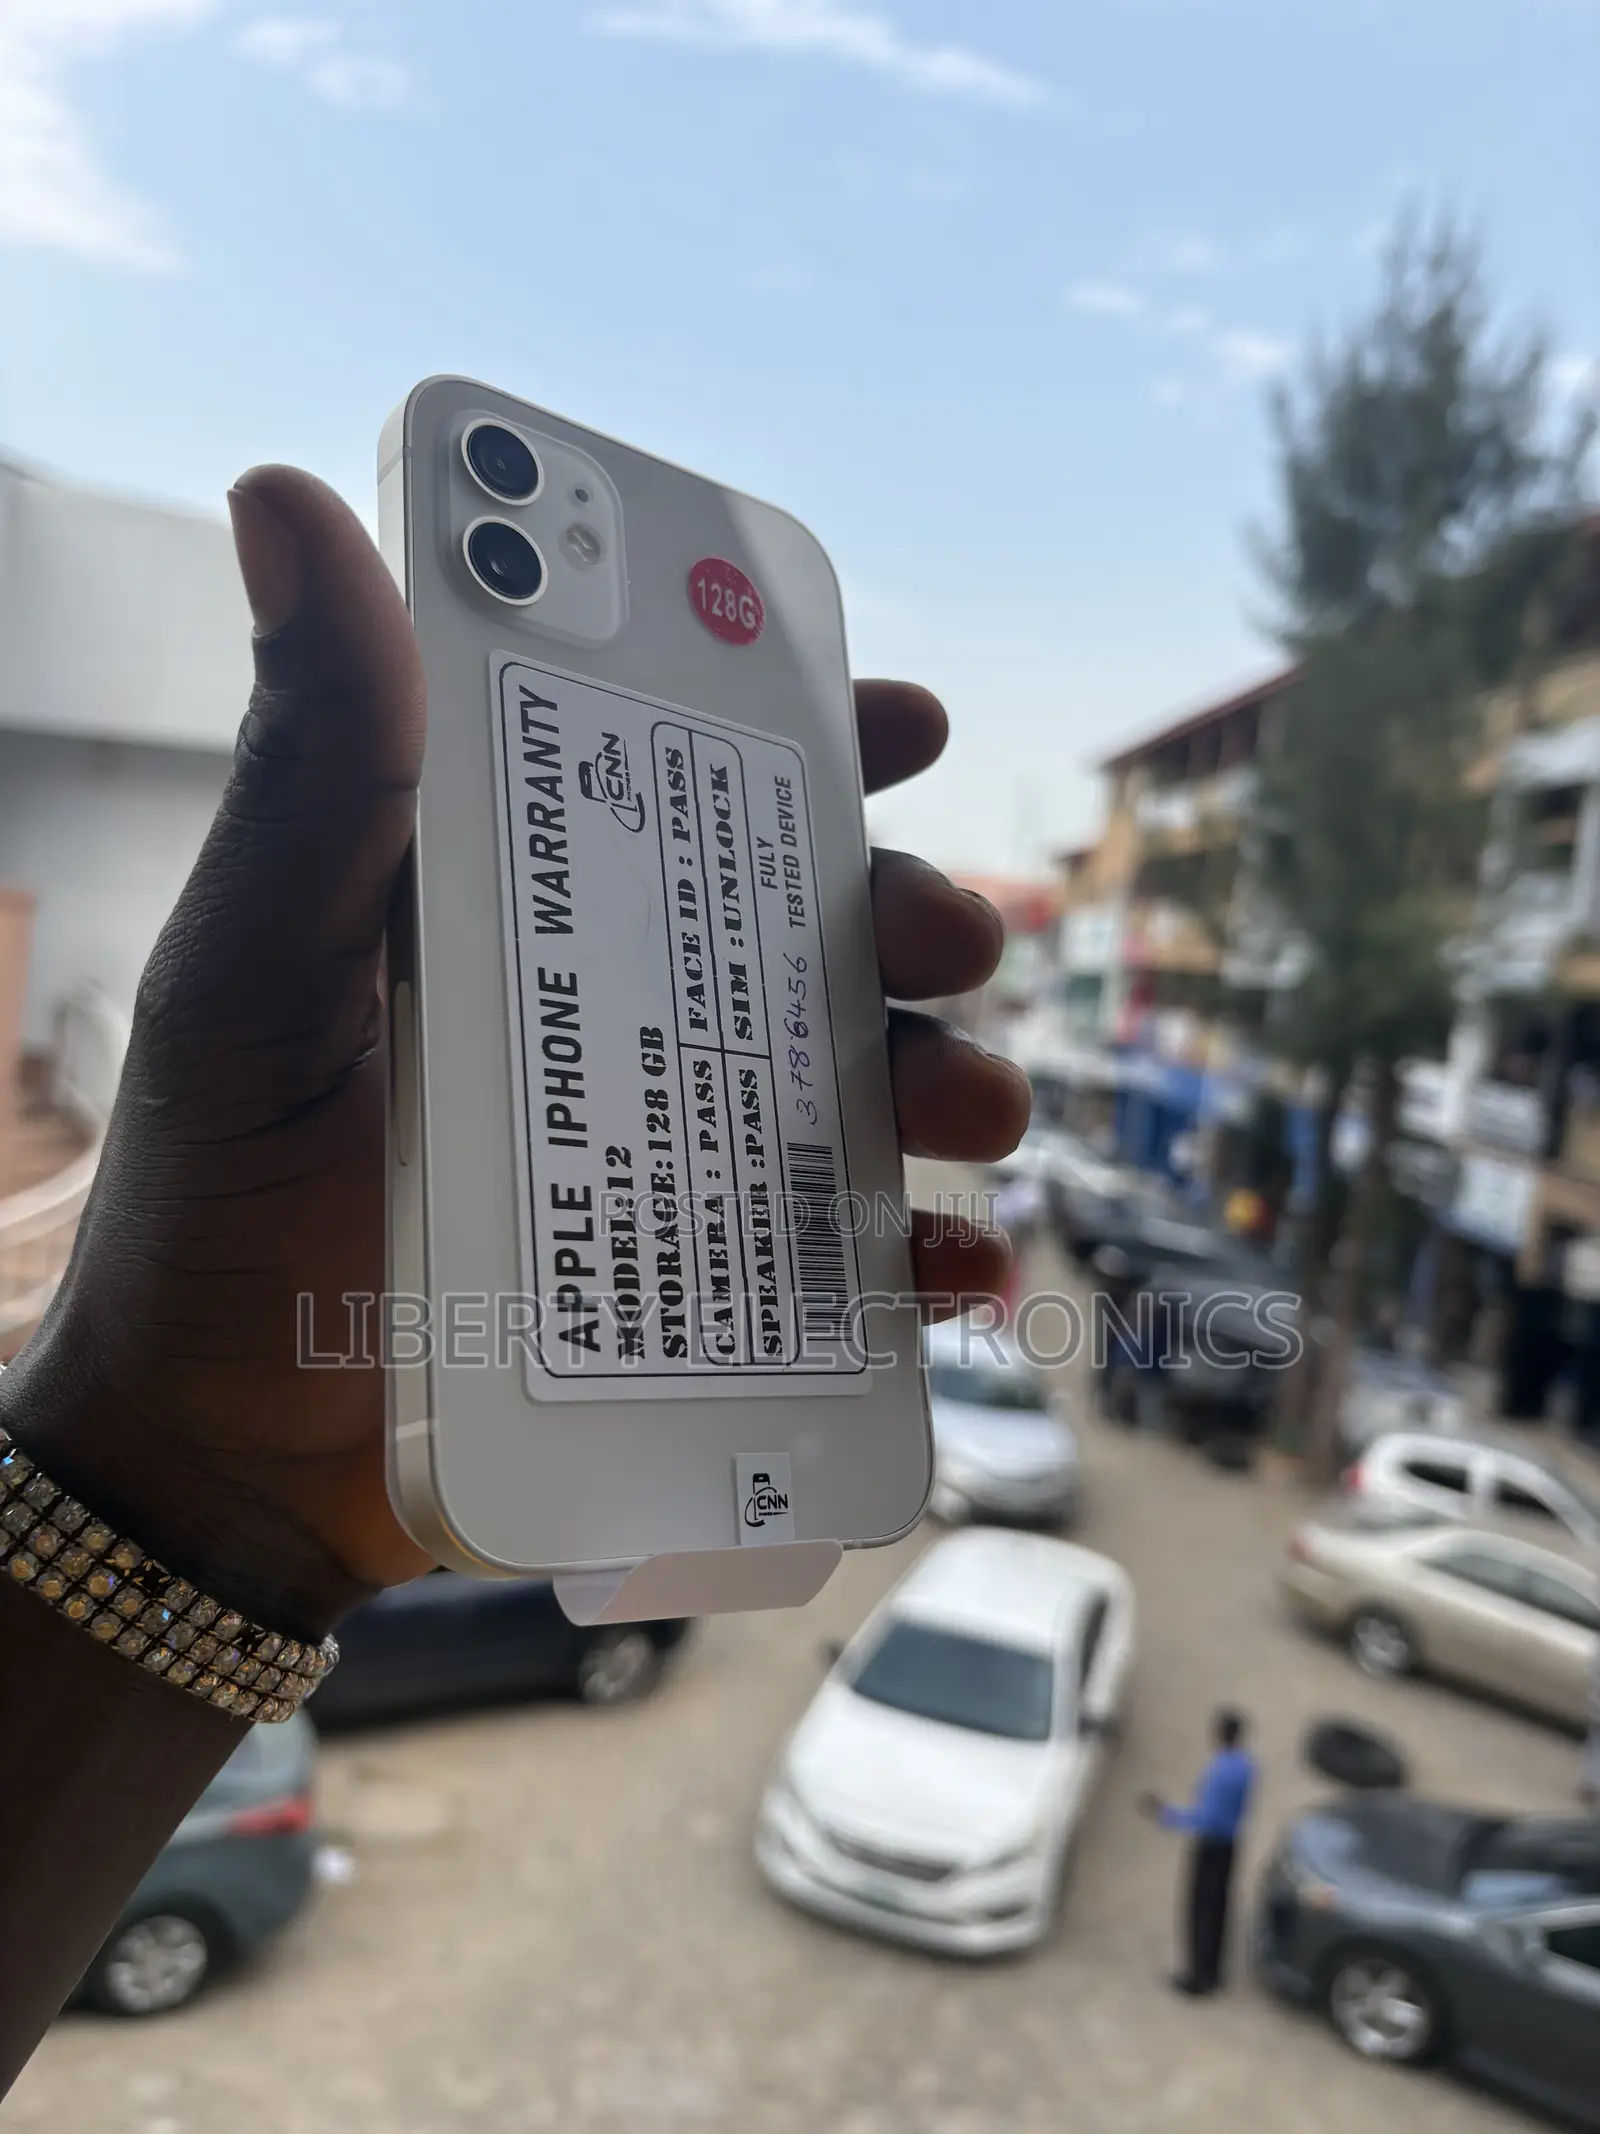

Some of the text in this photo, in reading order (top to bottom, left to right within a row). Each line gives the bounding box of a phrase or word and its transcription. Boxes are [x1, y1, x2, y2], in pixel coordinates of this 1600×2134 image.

[697, 577, 757, 630] 128G
[601, 732, 625, 802] CNN
[665, 747, 692, 843] PASS
[756, 836, 779, 890] FULY
[774, 775, 806, 930] TESTED DEVICE
[677, 878, 699, 922] ID
[518, 684, 602, 1353] APPLE IPHONE WARRANTY
[681, 932, 708, 1032] FACE
[729, 962, 753, 1041] SIM
[639, 1026, 667, 1077] GB
[693, 1060, 718, 1153] PASS
[704, 1195, 736, 1356] CAMERA
[750, 1181, 783, 1357] SPEAKER
[757, 1493, 788, 1510] CNN
